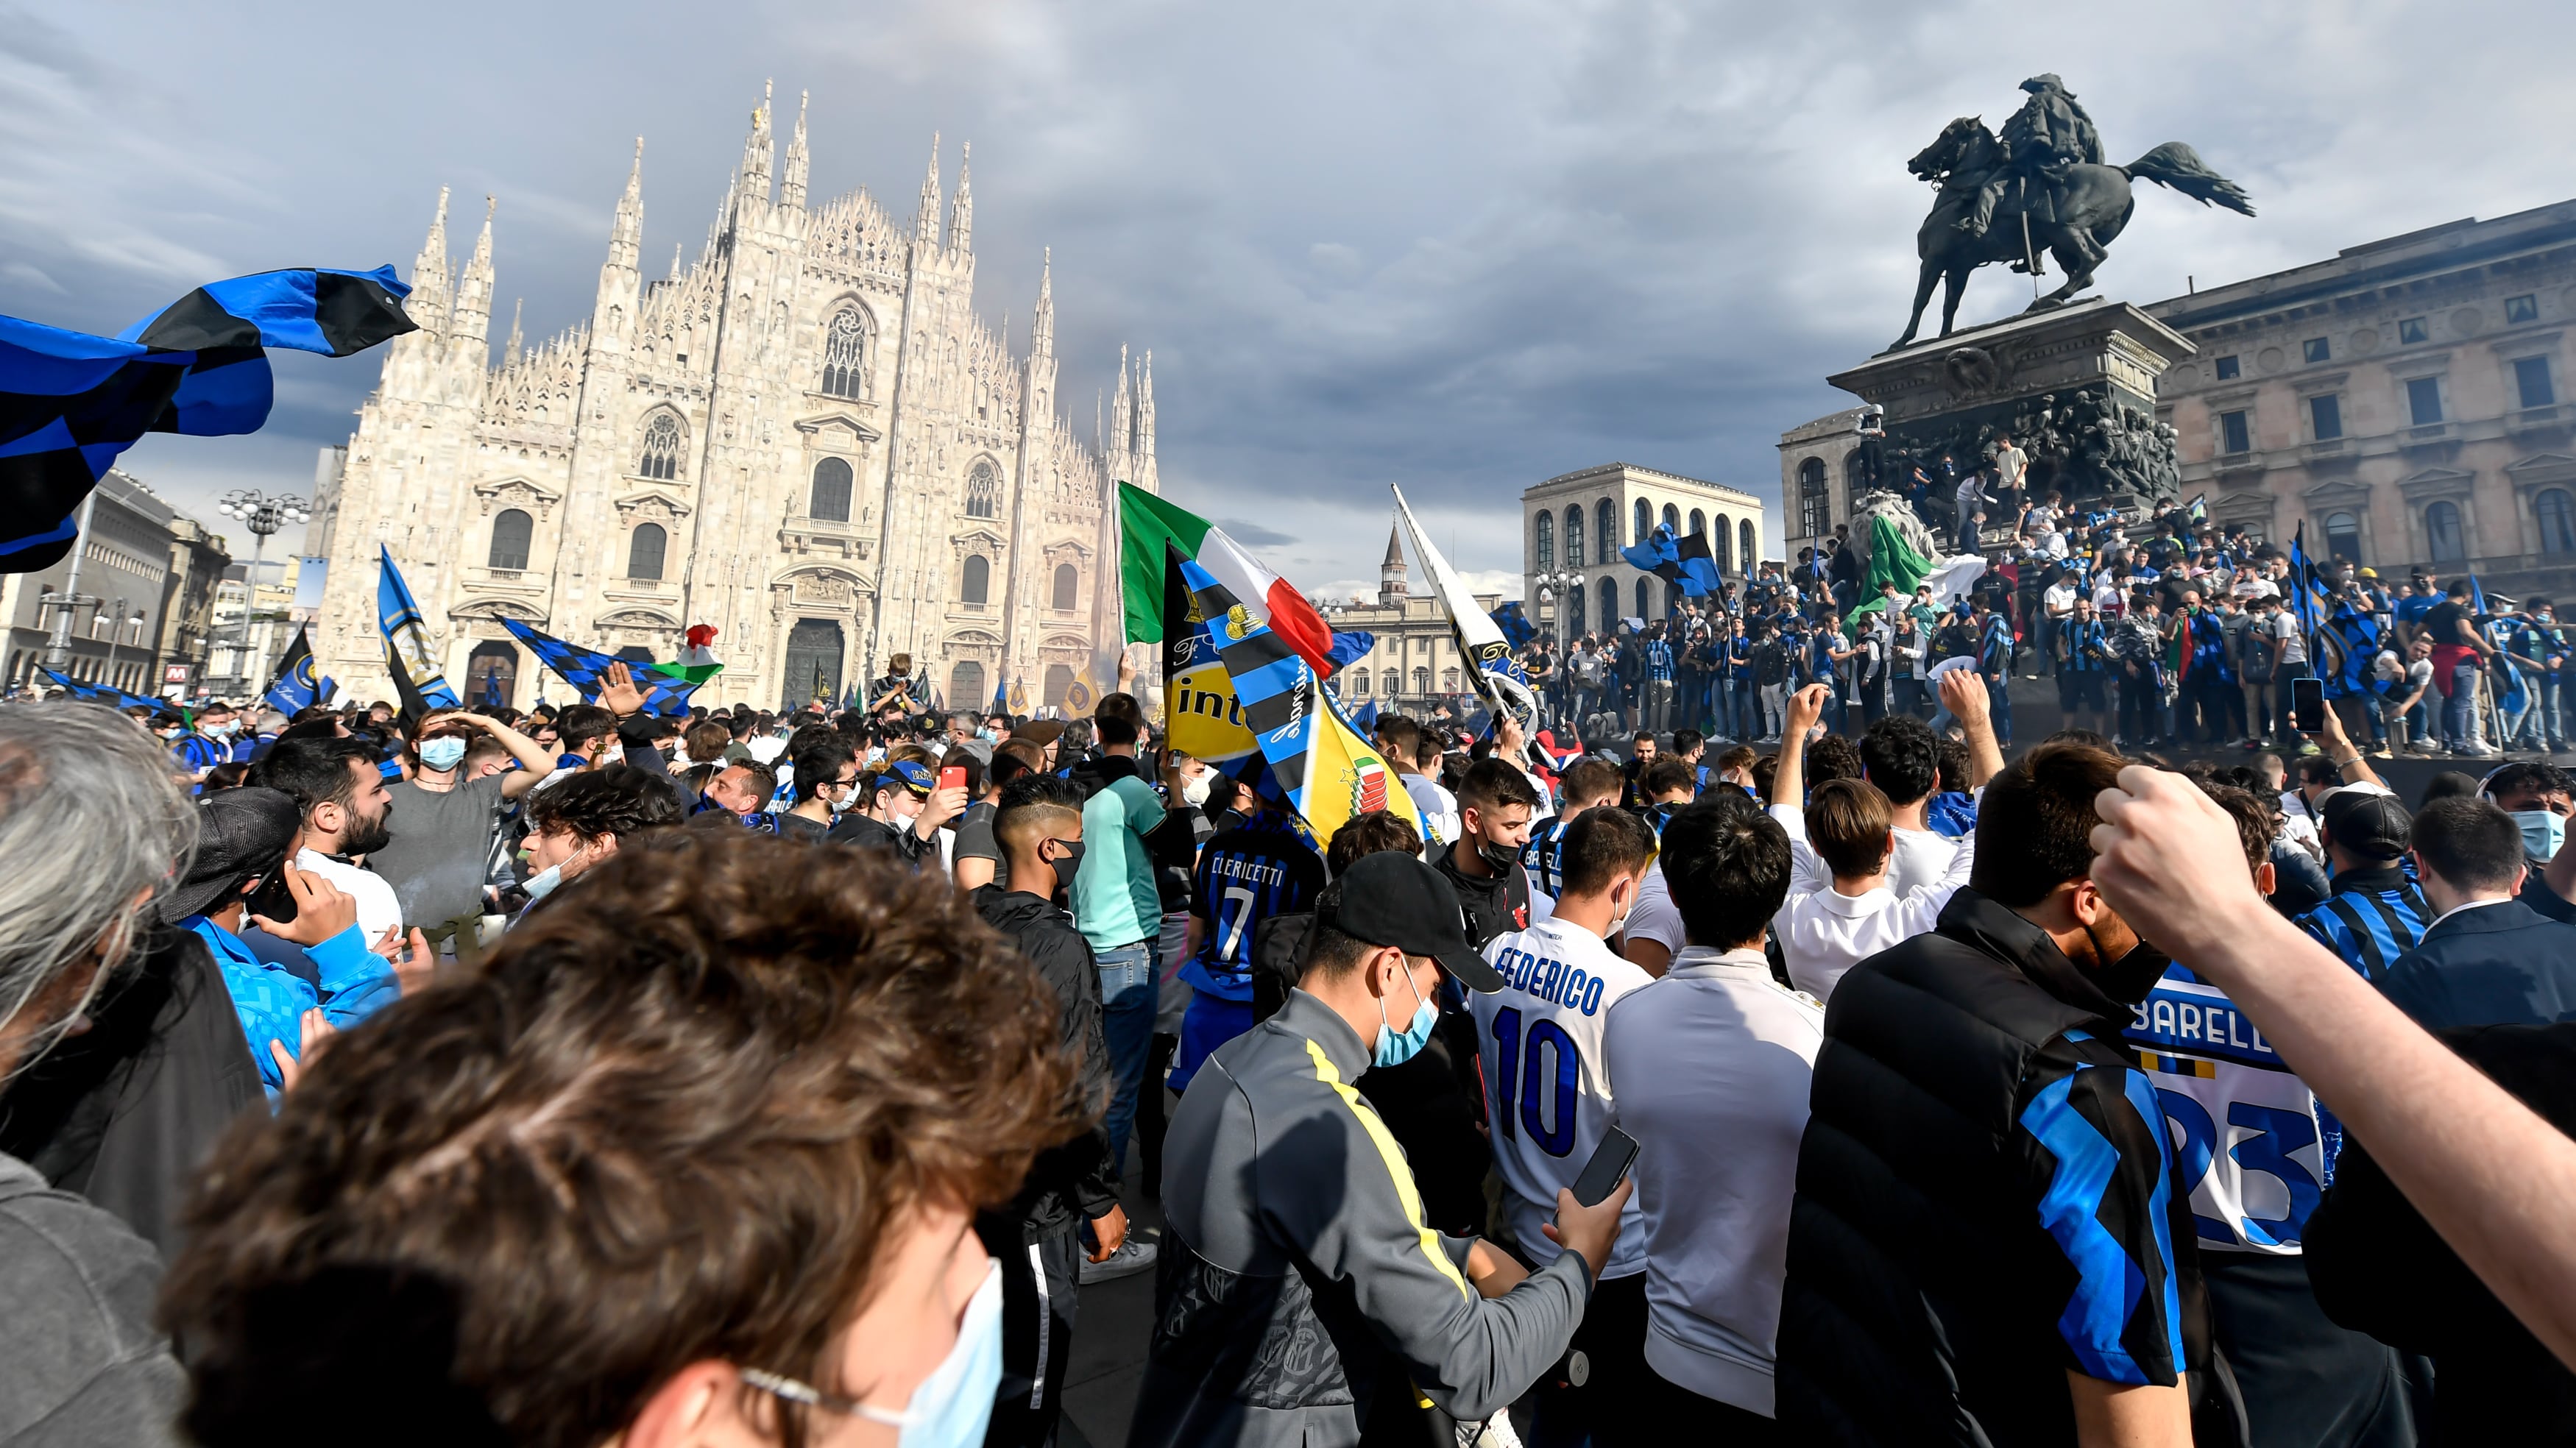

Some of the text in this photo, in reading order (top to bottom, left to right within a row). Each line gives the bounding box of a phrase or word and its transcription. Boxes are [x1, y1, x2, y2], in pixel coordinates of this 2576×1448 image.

[1649, 650, 1664, 666] 10
[1178, 675, 1254, 734] int
[911, 770, 933, 781] INT
[1211, 856, 1283, 887] CLERICETTI
[1220, 887, 1254, 962] 7
[1495, 947, 1604, 1017] FEDERICO
[2129, 999, 2272, 1054] BARELL
[1491, 1004, 1580, 1158] 10
[2155, 1087, 2326, 1247] 23
